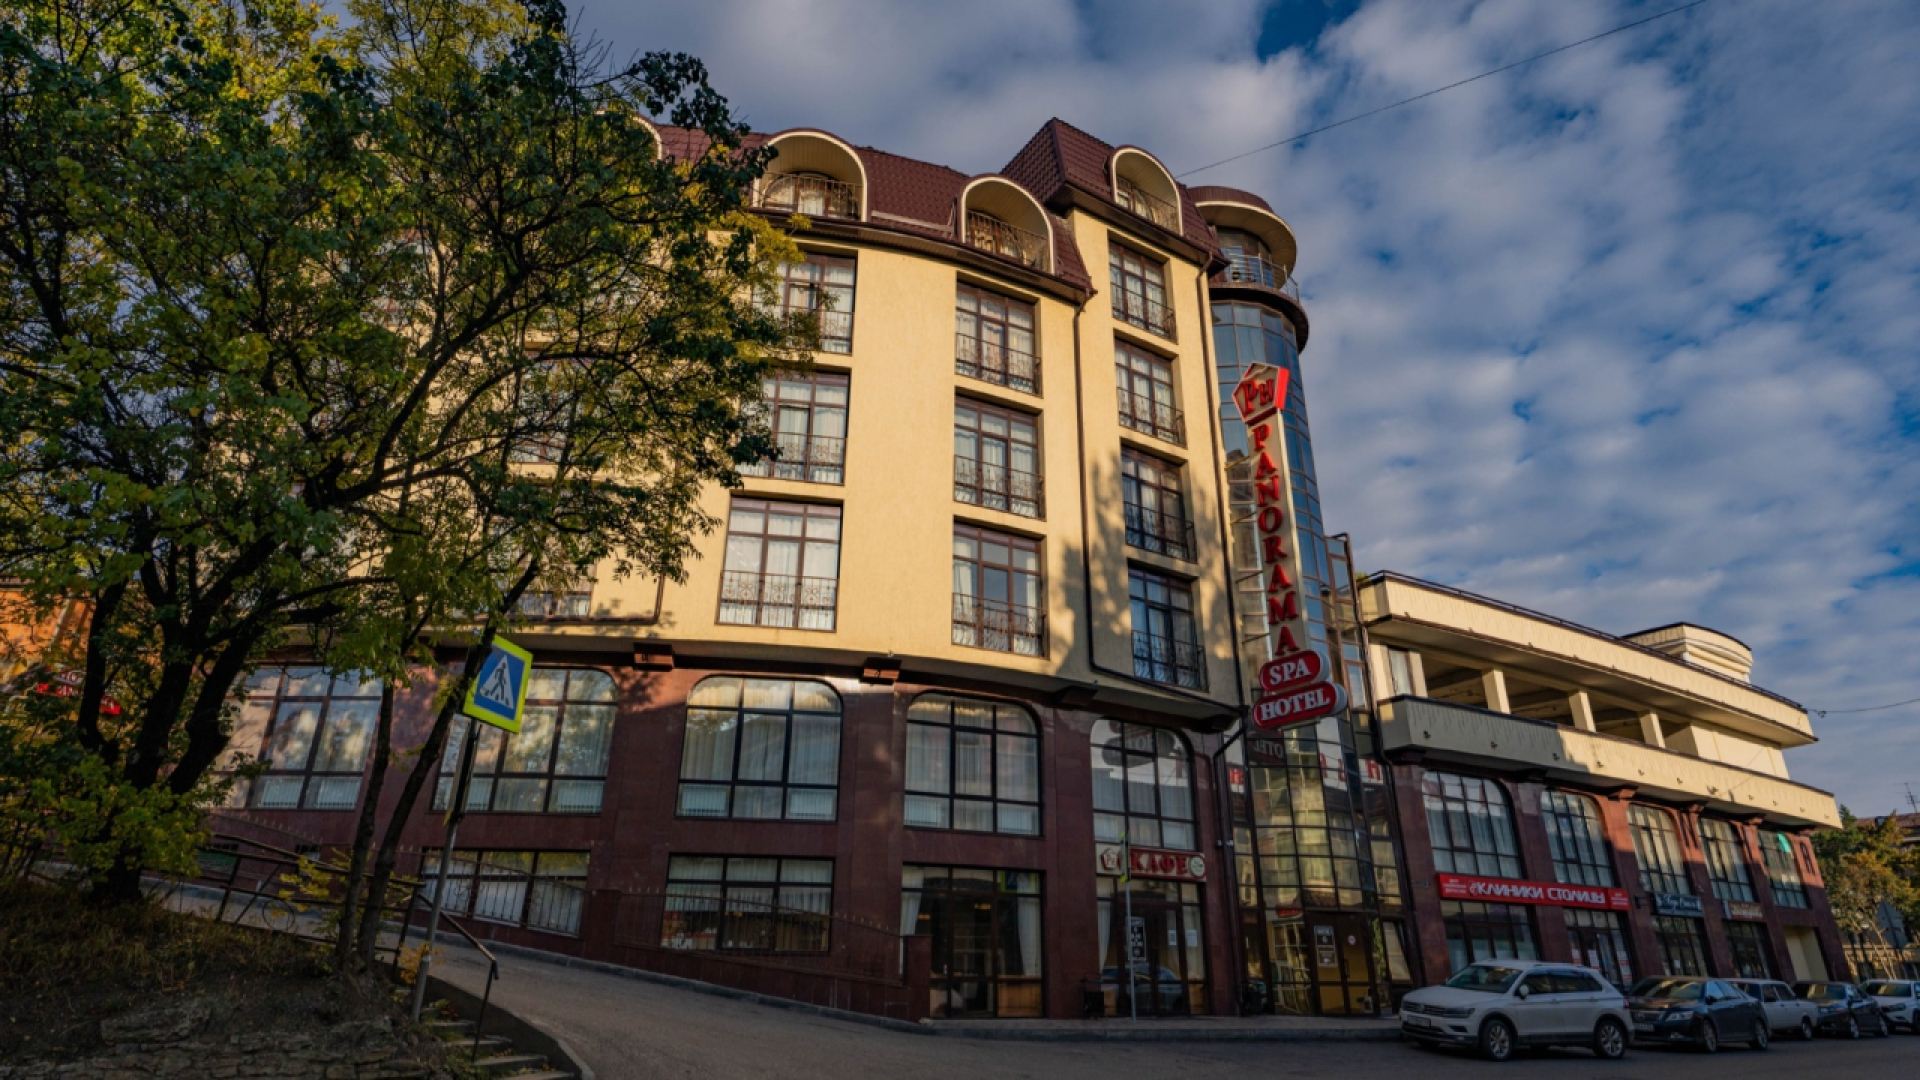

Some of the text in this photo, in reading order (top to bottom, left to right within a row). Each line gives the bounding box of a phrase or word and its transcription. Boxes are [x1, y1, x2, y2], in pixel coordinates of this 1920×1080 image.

[1252, 423, 1300, 655] PANORAMA
[1269, 658, 1311, 686] SPA
[1260, 688, 1330, 721] HOTEL
[1130, 852, 1189, 875] КАФЕ
[1477, 882, 1544, 899] КЛИНИКИ
[1547, 887, 1606, 904] СТОЛИЦЫ
